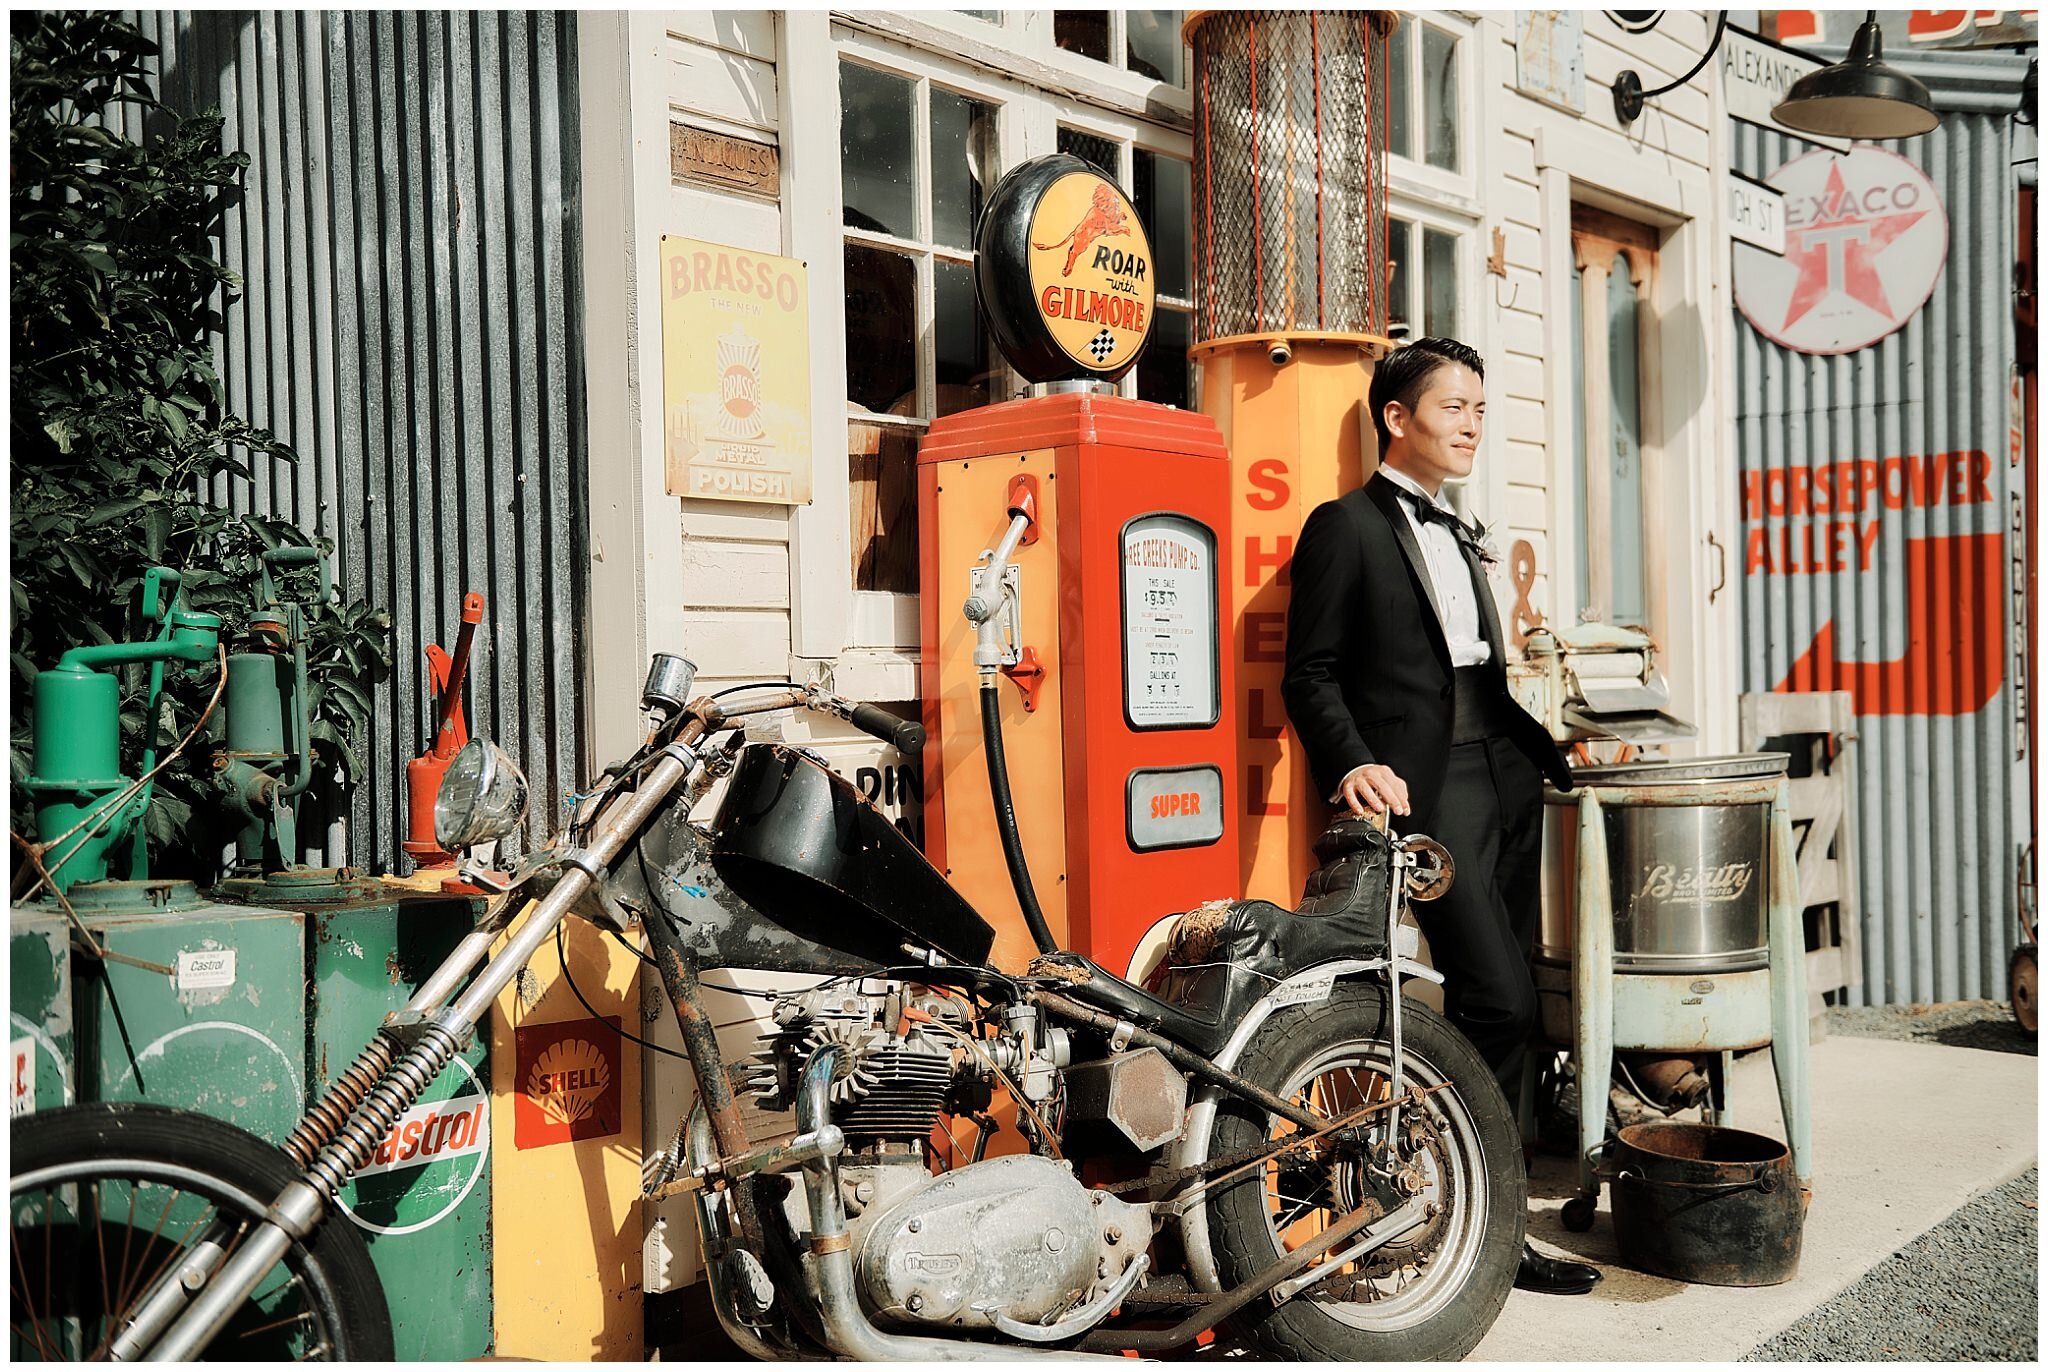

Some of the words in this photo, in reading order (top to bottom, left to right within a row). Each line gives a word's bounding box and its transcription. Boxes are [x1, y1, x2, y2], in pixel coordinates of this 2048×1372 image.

[1759, 199, 1773, 233] ST
[1092, 245, 1146, 282] ROAR
[1802, 222, 1871, 291] T
[669, 251, 799, 312] BRASSO
[1106, 278, 1140, 296] with
[711, 298, 731, 312] THE
[736, 302, 761, 316] NEW
[1041, 285, 1145, 333] GILMORE
[722, 374, 759, 406] BRASSO
[715, 451, 767, 465] METAL
[700, 471, 785, 498] POLISH
[1739, 450, 1994, 521] HORSEPOWER
[1143, 539, 1168, 568] CREEKS
[1170, 541, 1188, 569] PUMP
[1190, 551, 1201, 571] CO.
[1745, 519, 1881, 576] ALLEY
[1148, 578, 1159, 588] THIS
[1163, 579, 1176, 589] SALE
[1244, 459, 1292, 816] SHELL
[1149, 671, 1170, 680] GALLONS
[834, 766, 925, 807] DIN
[1151, 792, 1201, 819] SUPER
[1698, 887, 1734, 896] IMITED
[190, 959, 225, 972] Castrol
[540, 1068, 601, 1095] SHELL
[357, 1103, 484, 1170] astrol
